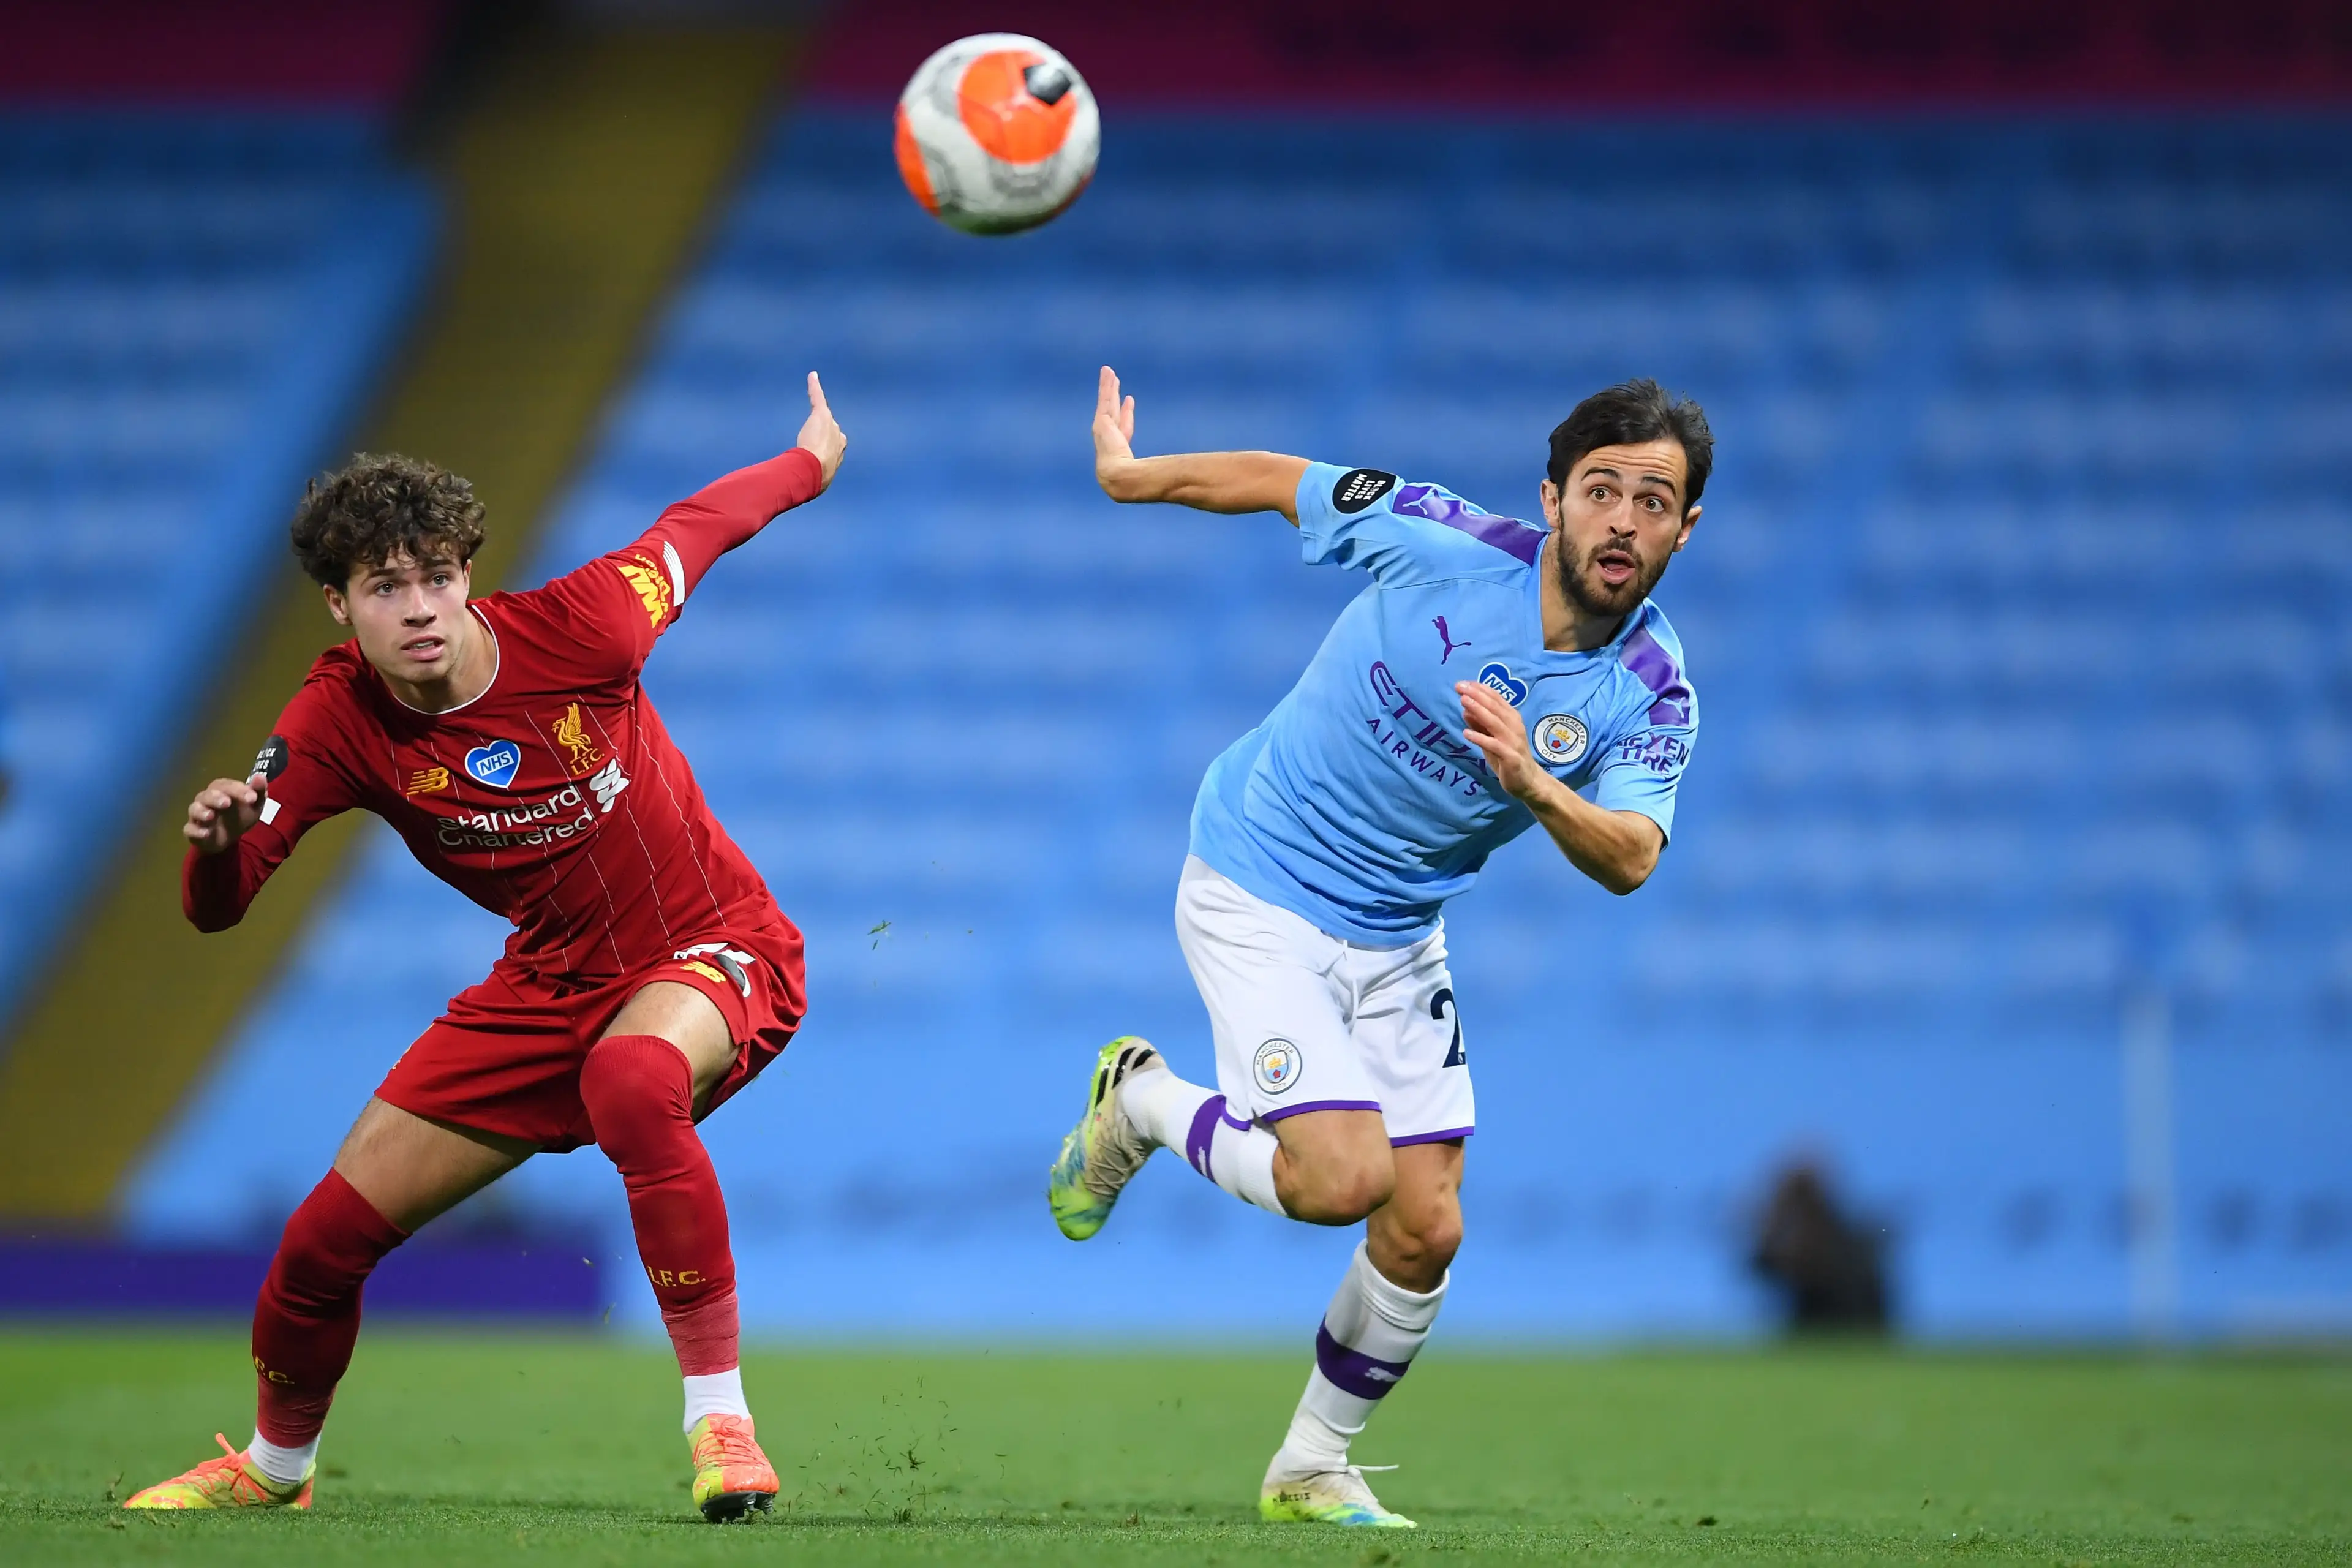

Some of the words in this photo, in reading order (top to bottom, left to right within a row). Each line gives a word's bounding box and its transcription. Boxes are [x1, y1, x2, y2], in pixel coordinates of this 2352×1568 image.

[1341, 473, 1368, 502] MATTER
[1354, 480, 1375, 499] LIVES
[1485, 676, 1515, 701] NHS
[1370, 660, 1499, 780] ETIHA
[1548, 717, 1585, 745] MANCHESTER
[480, 752, 510, 774] NHS
[571, 748, 605, 775] L.F.C.
[1366, 718, 1482, 796] AIRWAYS
[1542, 748, 1557, 760] CITY
[1622, 747, 1673, 774] TIRE
[437, 782, 581, 832] Standard
[438, 807, 595, 847] Chartered
